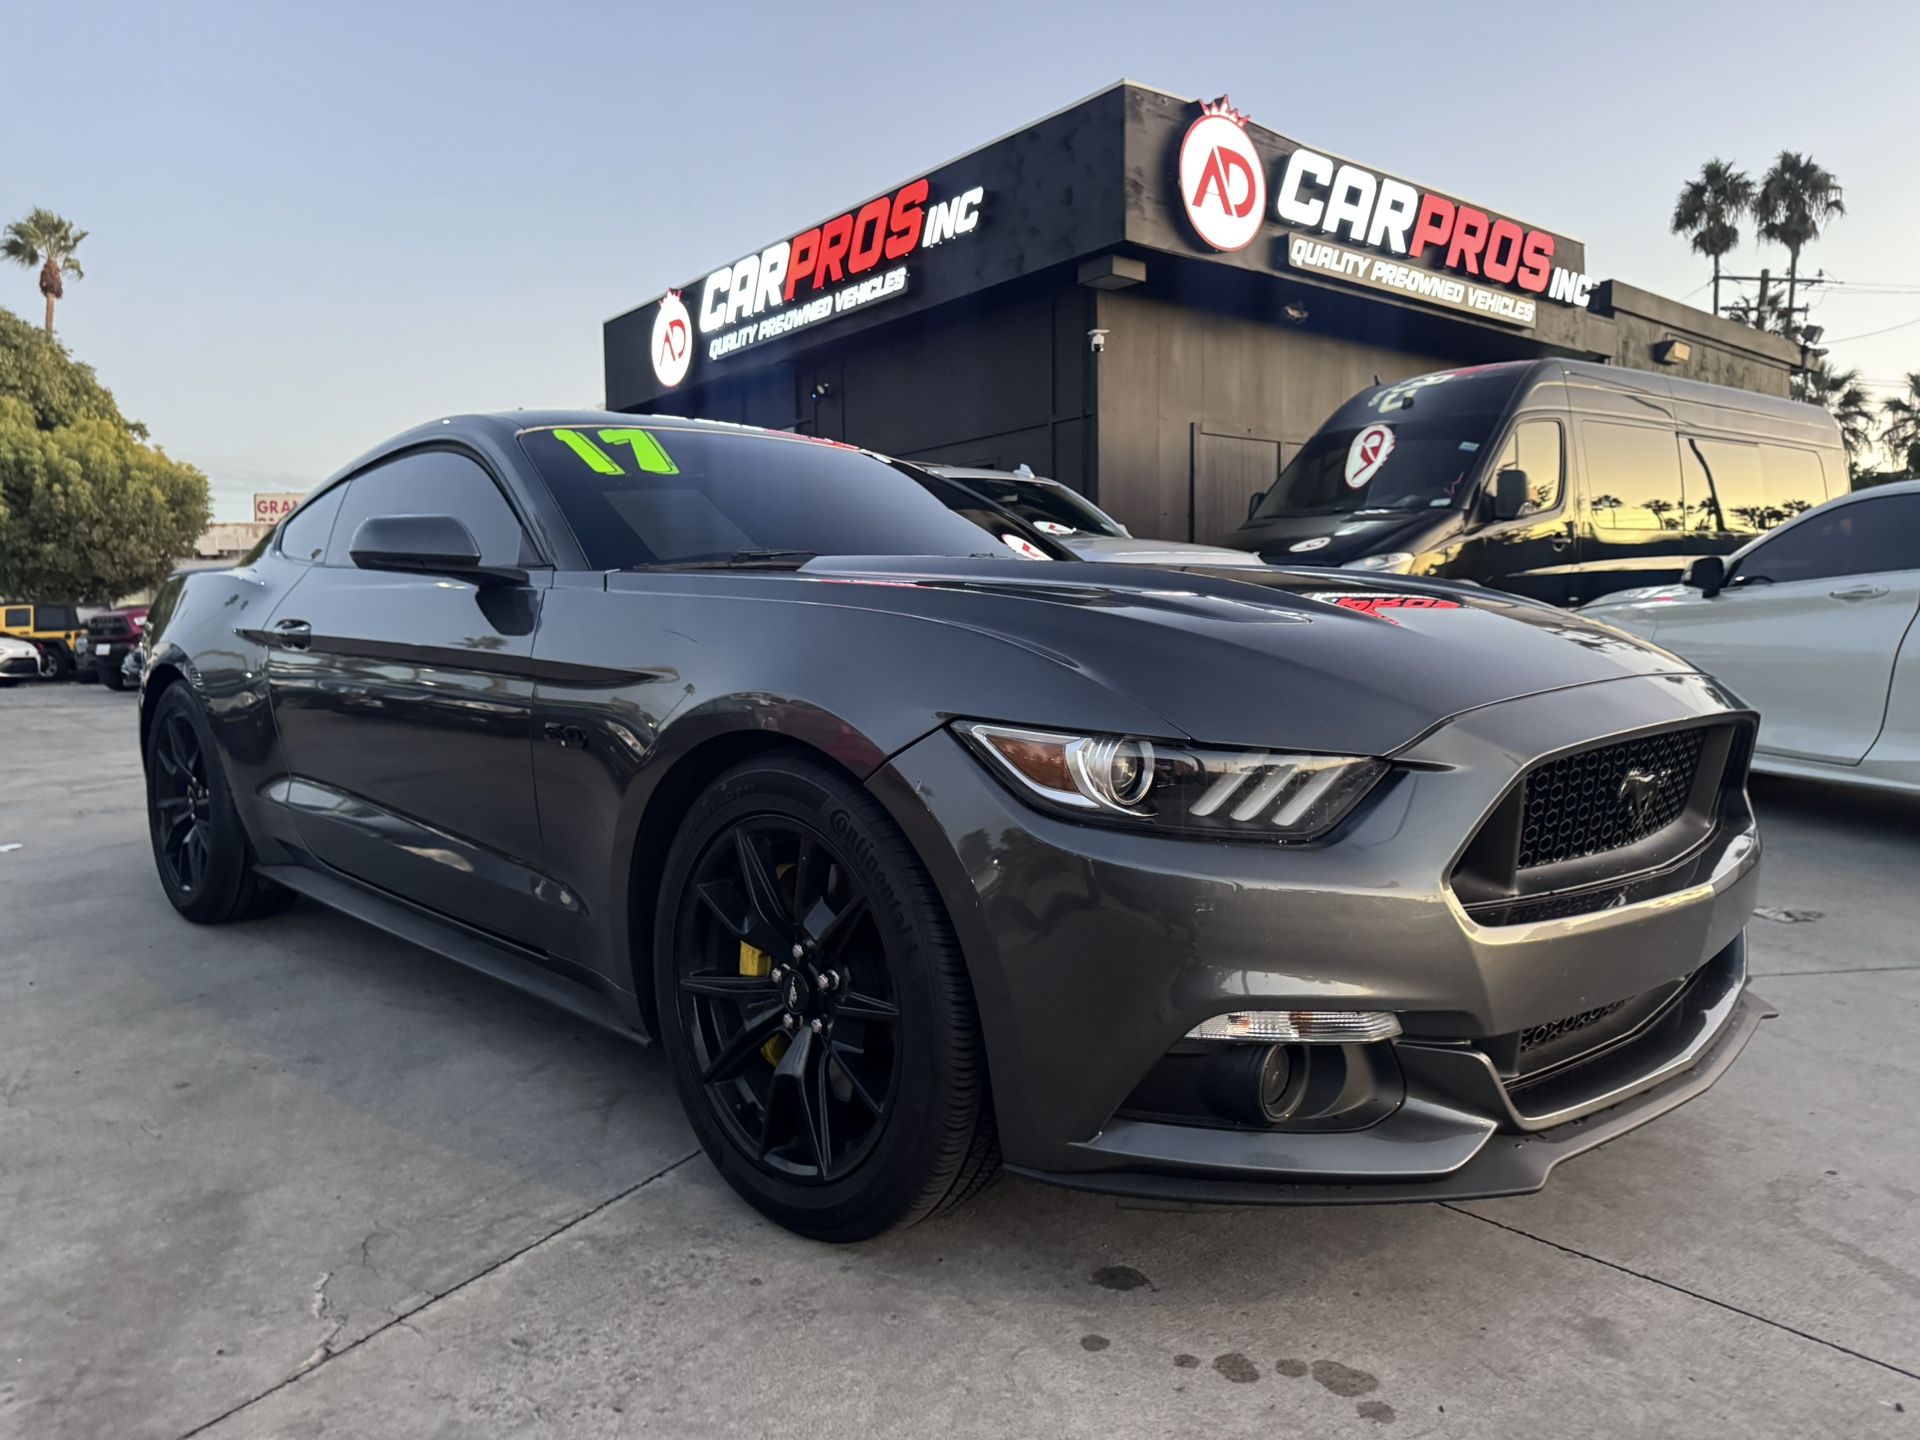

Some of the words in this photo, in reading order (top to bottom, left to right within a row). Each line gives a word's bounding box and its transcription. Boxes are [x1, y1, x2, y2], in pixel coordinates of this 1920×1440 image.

[922, 186, 984, 248] INC
[1291, 238, 1370, 278] QUALITY
[1466, 287, 1536, 323] VEHICLES
[1548, 266, 1592, 307] INC
[708, 322, 760, 360] QUALITY
[835, 265, 907, 313] VEHICLES
[553, 428, 680, 475] 17
